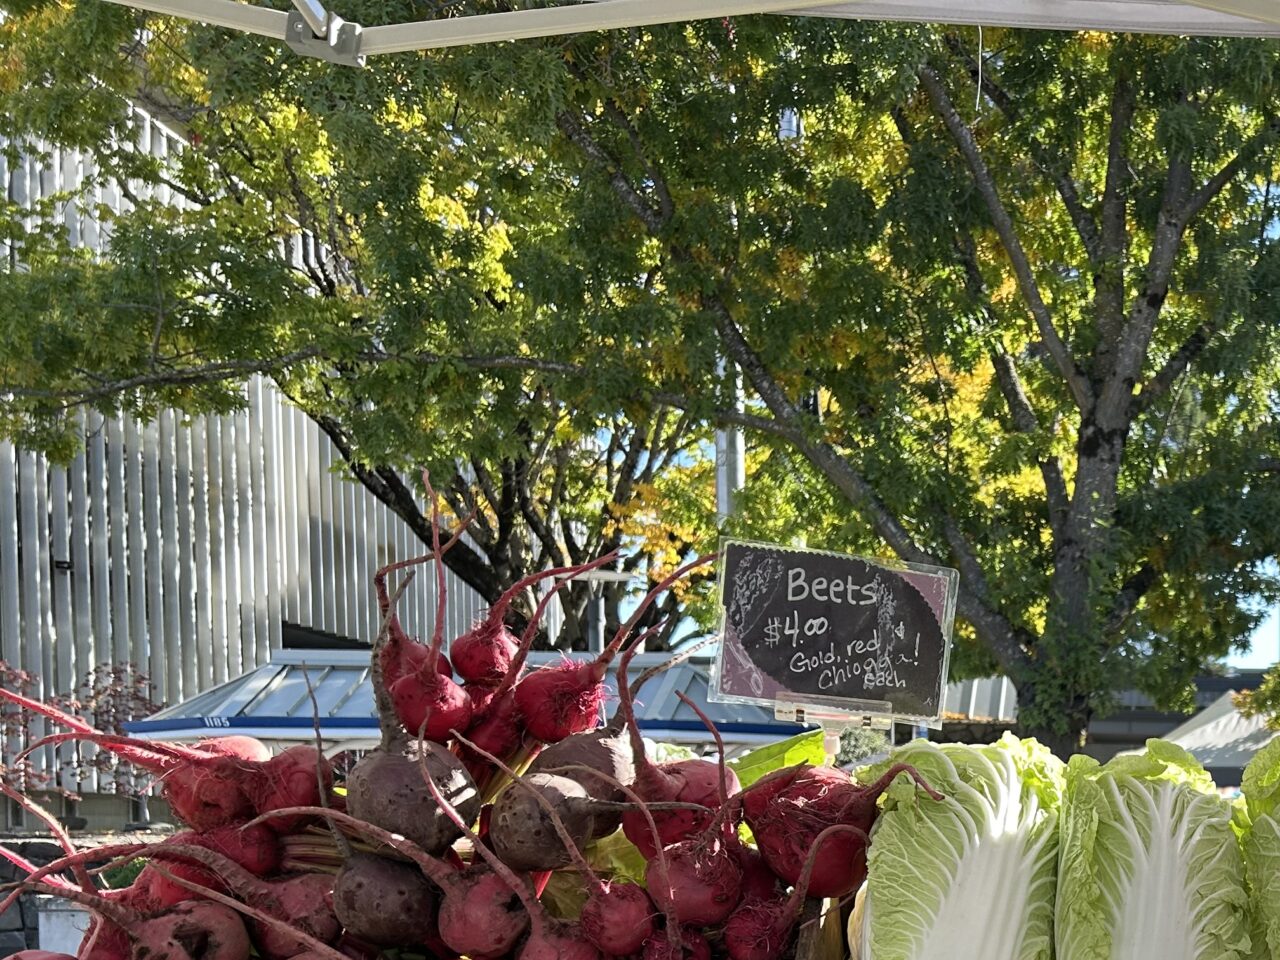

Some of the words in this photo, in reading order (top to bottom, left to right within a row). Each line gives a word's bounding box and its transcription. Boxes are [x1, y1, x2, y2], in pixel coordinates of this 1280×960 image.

[787, 567, 878, 606] Beets
[763, 610, 828, 648] $4.00
[846, 628, 880, 656] red
[863, 670, 906, 688] each
